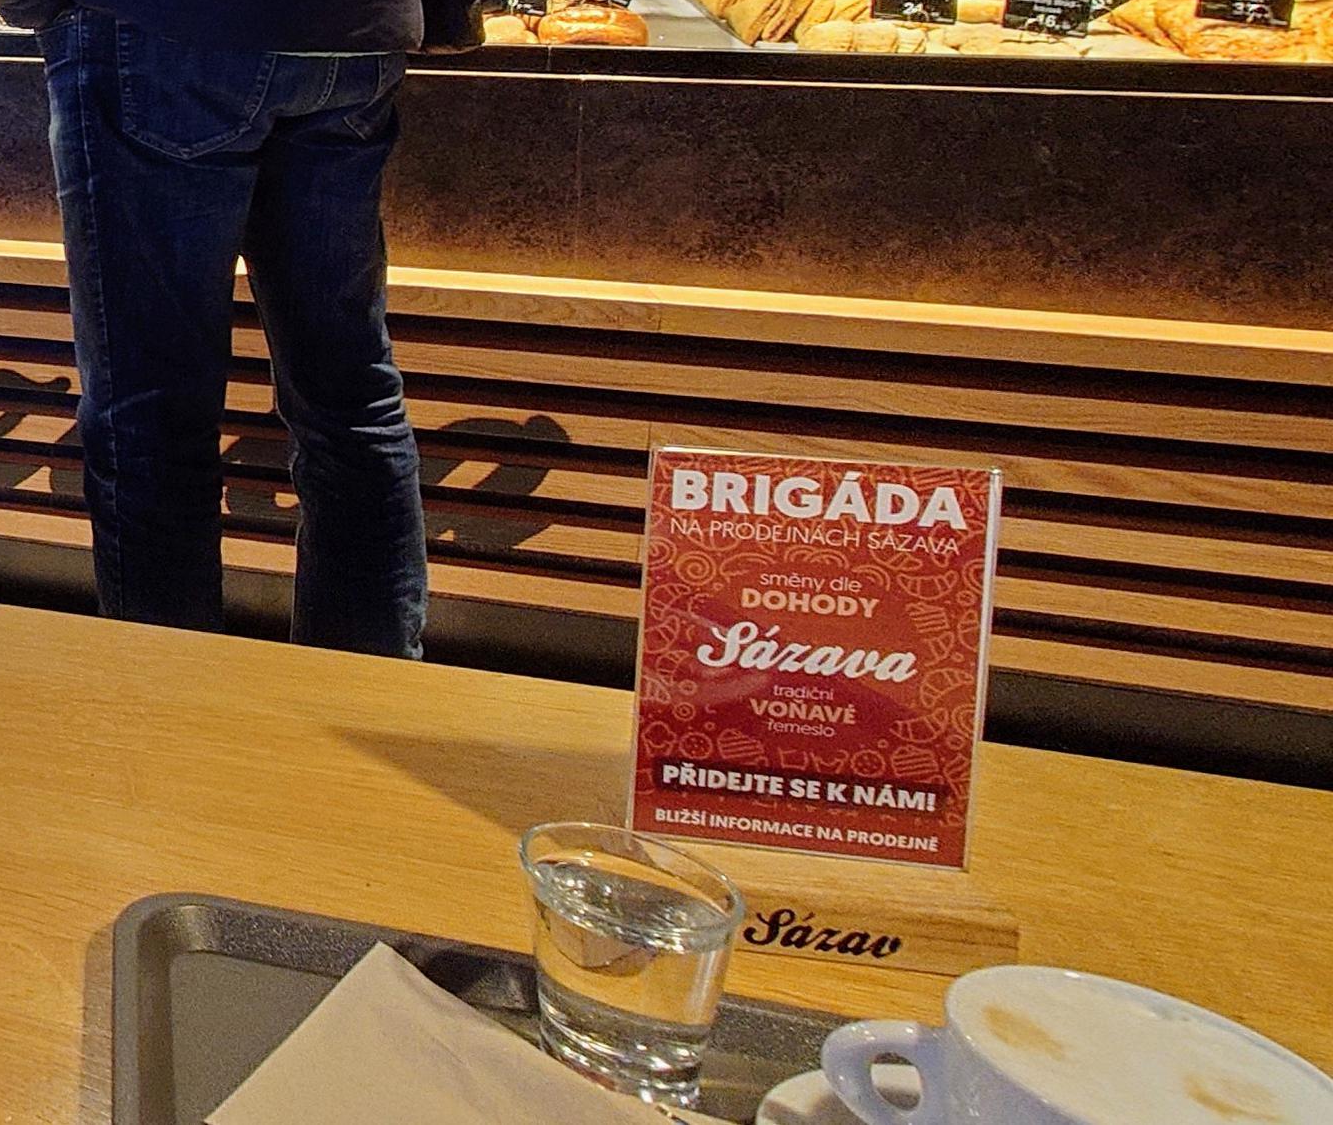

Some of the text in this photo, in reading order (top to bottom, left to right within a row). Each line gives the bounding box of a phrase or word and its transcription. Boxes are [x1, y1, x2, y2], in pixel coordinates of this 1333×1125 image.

[671, 468, 968, 531] BRIGÁDA
[671, 516, 960, 556] NA PRODEJNÁCH SÁZAVA
[760, 572, 863, 595] směny dle
[742, 586, 880, 620] DOHODY
[698, 621, 917, 683] Sázava
[773, 683, 834, 702] tradiční
[751, 697, 857, 726] VOŇAVÉ
[767, 718, 836, 738] řemeslo
[663, 762, 937, 812] PŘIDEJTE SE K NÁM!
[655, 807, 939, 852] BLIŽŠÍ INFORMACE NA PRODEJNĚ
